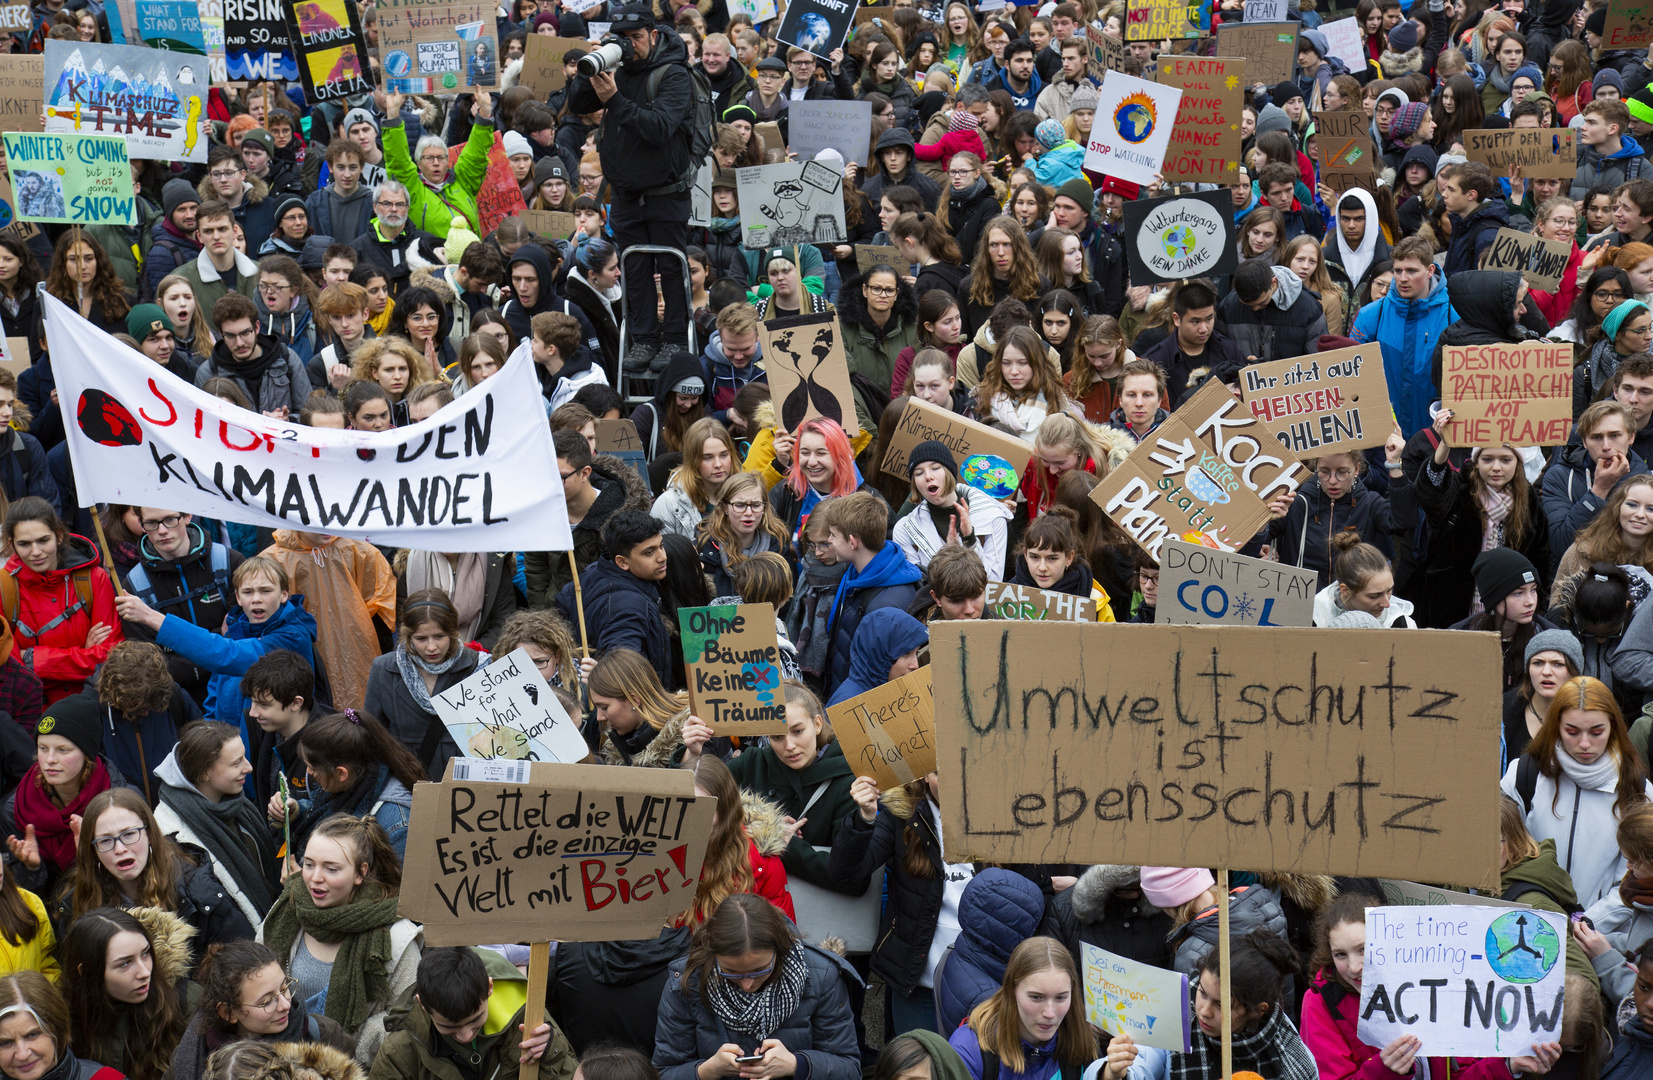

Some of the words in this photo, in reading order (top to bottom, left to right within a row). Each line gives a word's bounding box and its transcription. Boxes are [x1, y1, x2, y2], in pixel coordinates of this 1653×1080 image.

[142, 4, 169, 17] WHAT
[178, 5, 182, 18] I
[379, 14, 399, 27] tut
[406, 6, 482, 30] Wahrheit
[1128, 8, 1150, 24] NOT
[1152, 5, 1200, 24] CLIMATE
[1246, 3, 1277, 18] OCEAN
[144, 18, 177, 31] STAND
[182, 18, 201, 32] FOR
[227, 36, 246, 45] AND
[250, 28, 270, 44] SO
[272, 36, 288, 46] ARE
[301, 25, 356, 46] LINDNER
[1128, 21, 1186, 40] CHANGE
[1219, 28, 1274, 48] CLIMATE
[1611, 28, 1646, 45] Expect
[158, 39, 170, 50] IS
[383, 31, 412, 48] kund
[420, 43, 458, 54] SKOLSTREJK
[1086, 24, 1102, 46] RAISE
[1105, 38, 1122, 56] YOUR
[243, 52, 284, 80] WE
[419, 58, 460, 72] KLIMATET
[538, 66, 558, 78] vor
[1175, 60, 1225, 76] EARTH
[68, 80, 180, 114] KLIMASCHUTZ
[314, 73, 369, 100] GRETA
[1183, 82, 1211, 90] WILL
[89, 105, 172, 138] TIME
[1174, 112, 1226, 126] limate
[1322, 114, 1365, 136] NUR
[4, 136, 65, 162] WINTER
[66, 142, 74, 154] is
[76, 138, 128, 164] COMING
[1171, 130, 1222, 146] CHANGE
[1520, 132, 1542, 146] DEN
[1090, 141, 1111, 155] STOP
[1114, 148, 1156, 169] WATCHING
[1184, 149, 1202, 157] we
[86, 166, 102, 178] but
[109, 166, 123, 178] it's
[96, 178, 113, 186] not
[87, 186, 118, 194] gonna
[71, 196, 134, 222] SNOW
[530, 212, 570, 232] THERE
[1145, 206, 1217, 235] Weltuntergang
[864, 248, 888, 263] There
[894, 255, 902, 264] is
[1150, 254, 1174, 272] NEIN
[1177, 247, 1210, 272] DANKE
[1448, 348, 1534, 372] DESTROY
[1536, 347, 1571, 369] THE
[1246, 368, 1278, 392] Ihr
[1283, 361, 1322, 387] sitzt
[1328, 354, 1364, 380] auf
[1450, 372, 1574, 402] PATRIARCHY
[1250, 386, 1344, 422] HEISSEN
[1484, 401, 1528, 418] NOT
[396, 393, 494, 463] DEN
[899, 406, 971, 456] Klimaschutz
[1450, 418, 1483, 443] THE
[1499, 418, 1573, 444] PLANET
[1194, 398, 1304, 501] Koch
[149, 440, 509, 528] KLIMAWANDEL
[1198, 450, 1240, 492] Kaffee
[1158, 478, 1215, 532] statt
[1168, 548, 1250, 584] DON'T
[1257, 568, 1314, 600] STAY
[1040, 589, 1091, 622] THE
[690, 611, 746, 634] Ohne
[704, 638, 777, 664] Bäume
[439, 683, 476, 710] We
[480, 654, 522, 692] stand
[957, 628, 1460, 735] Umweltschutz
[476, 696, 522, 734] What
[478, 692, 497, 712] for
[705, 698, 786, 723] Träume
[844, 688, 920, 734] There's
[474, 738, 508, 760] We
[514, 709, 559, 747] stand
[860, 718, 930, 772] Planet
[1157, 721, 1243, 774] ist
[960, 750, 1447, 838] Lebensschutz
[451, 786, 552, 834] Rettet
[556, 790, 610, 830] die
[615, 796, 696, 841] WELT
[436, 837, 468, 876] Es
[472, 836, 502, 868] ist
[512, 830, 559, 859] die
[564, 830, 658, 866] einzige
[434, 866, 516, 918] Welt
[527, 864, 573, 910] mit
[579, 843, 694, 912] Bier!
[1369, 912, 1405, 940] The
[1416, 916, 1468, 936] time
[1087, 946, 1108, 970] Sei
[1112, 963, 1126, 975] ein
[1369, 943, 1386, 966] is
[1087, 966, 1149, 1003] Ehrenmann
[1090, 984, 1103, 994] und
[1104, 990, 1119, 1002] rette
[1122, 998, 1132, 1008] die
[1361, 978, 1448, 1025] ACT
[1464, 978, 1564, 1033] NOW
